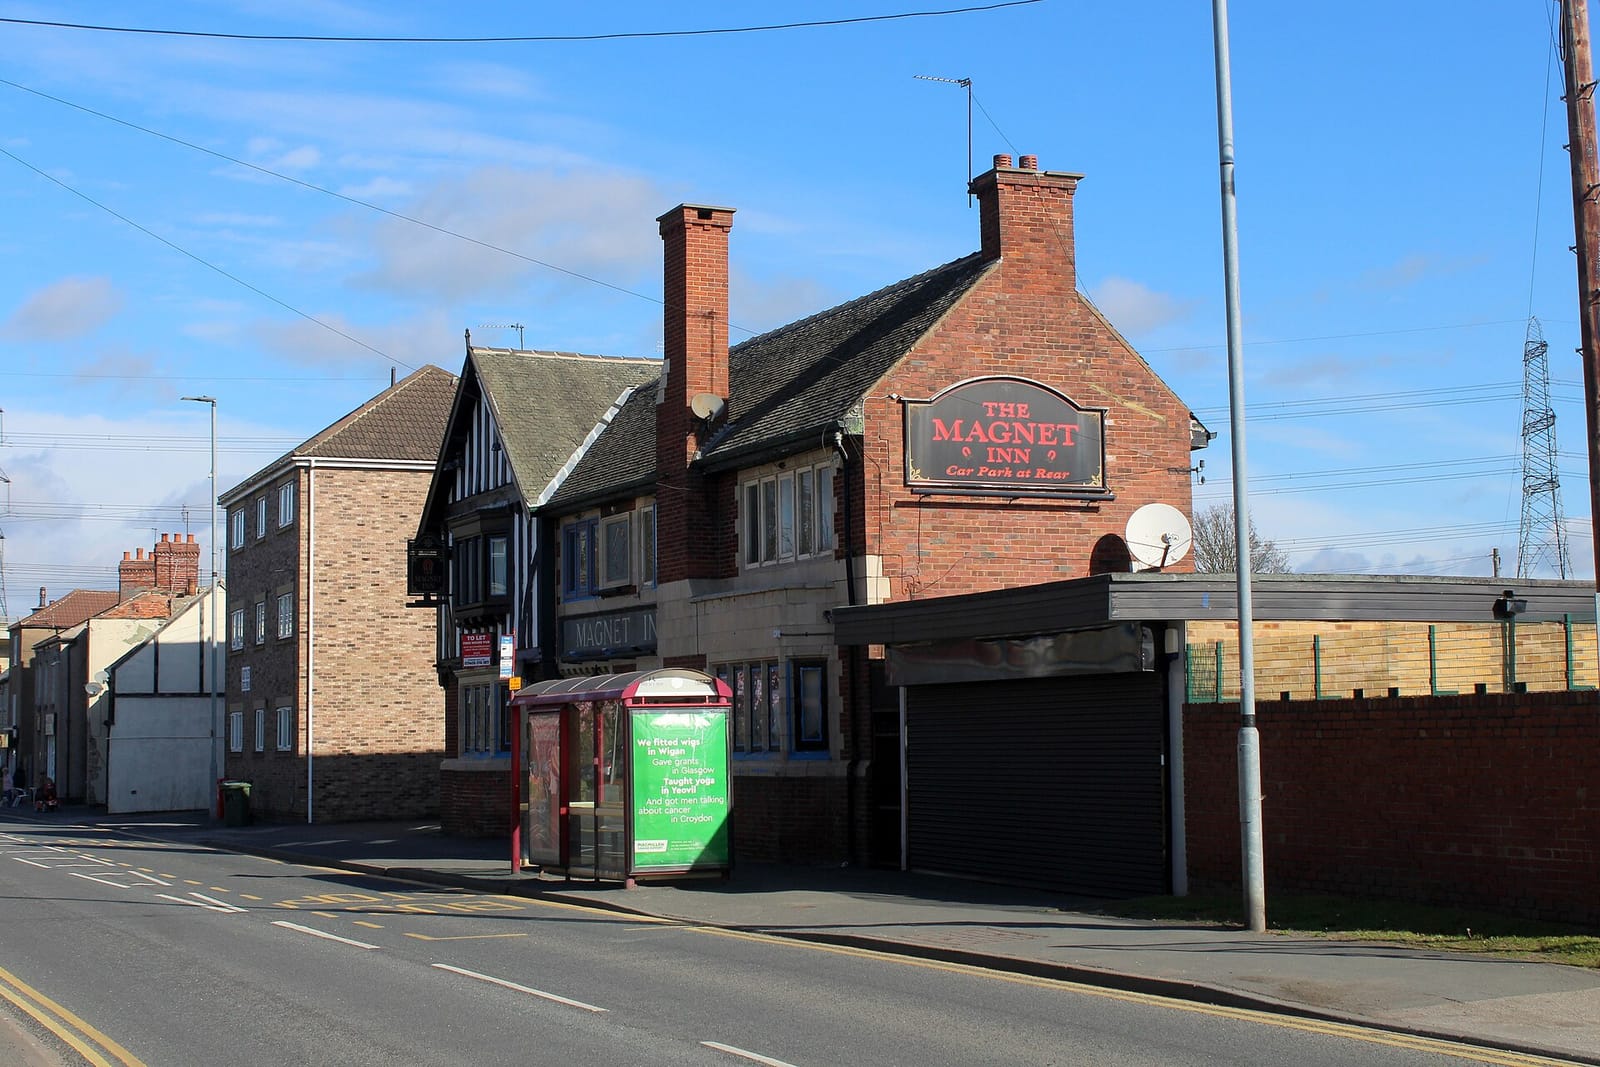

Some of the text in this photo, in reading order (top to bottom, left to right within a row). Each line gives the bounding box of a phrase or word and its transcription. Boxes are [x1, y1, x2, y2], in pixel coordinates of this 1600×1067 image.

[982, 401, 1030, 419] THE
[932, 418, 1079, 446] MAGNET
[986, 447, 1032, 464] INN
[946, 465, 1070, 480] Car Park at Rear
[576, 617, 631, 648] MAGNET
[637, 737, 700, 748] We fitted wigs
[647, 747, 686, 757] in Wigan
[652, 758, 699, 767] Gave grants
[681, 766, 715, 776] Glasgow
[664, 777, 715, 787] Taught yoga
[661, 785, 697, 795] in Yeovil
[646, 797, 662, 805] And
[664, 798, 678, 807] got
[700, 795, 724, 805] talking
[638, 806, 691, 815] about cancer
[671, 813, 713, 824] in Croydon
